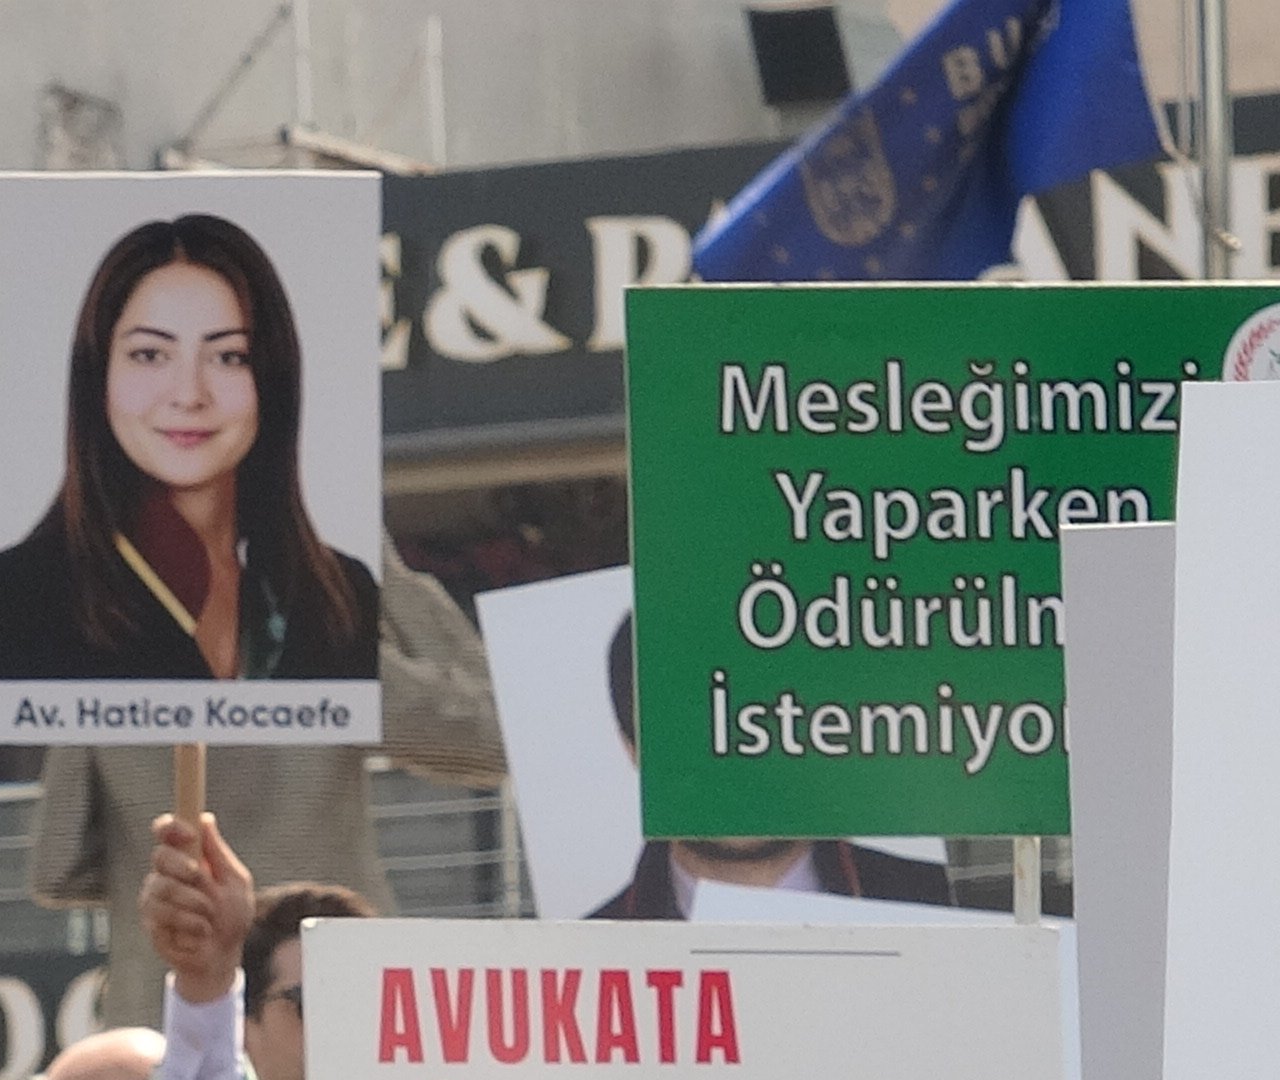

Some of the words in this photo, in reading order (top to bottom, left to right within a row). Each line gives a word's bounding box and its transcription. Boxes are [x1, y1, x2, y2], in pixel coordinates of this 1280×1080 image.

[719, 359, 1201, 454] Mesleğimiz
[774, 467, 1151, 560] Yaparken
[14, 698, 65, 728] Av.
[76, 698, 194, 728] Hatice
[204, 697, 353, 728] Kocaefe
[710, 670, 1069, 775] İstemiyo
[377, 967, 743, 1065] AVUKATA
